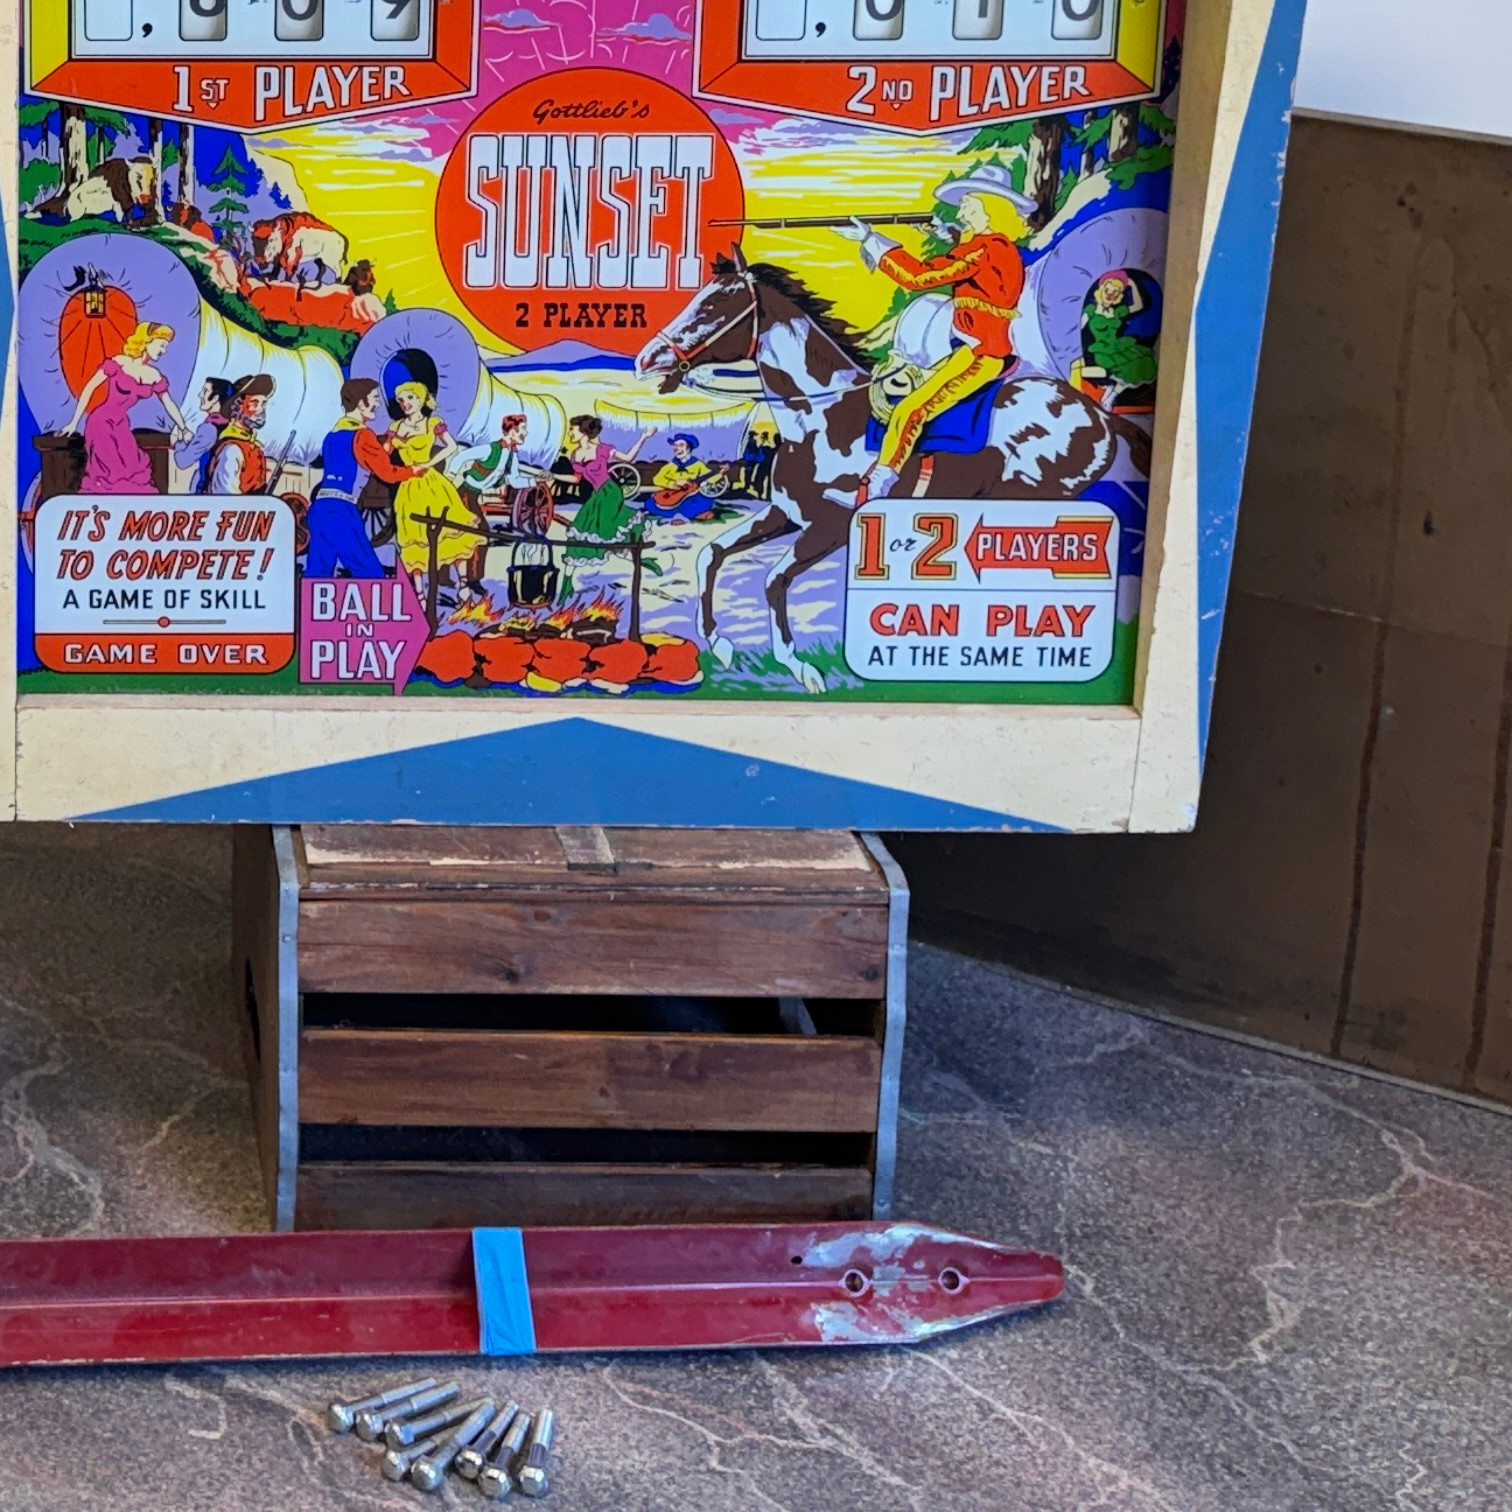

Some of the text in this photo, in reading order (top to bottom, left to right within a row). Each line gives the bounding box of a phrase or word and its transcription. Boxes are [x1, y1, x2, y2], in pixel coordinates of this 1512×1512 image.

[253, 65, 411, 122] PLAYER
[930, 65, 1090, 122] PLAYER
[532, 99, 650, 125] Gottlieb's
[464, 132, 715, 289] SUNSET
[515, 303, 647, 328] 2 PLAYER
[57, 505, 276, 542] IT'S MORE FUN
[854, 512, 1098, 580] 1 or 2 PLAYERS
[56, 549, 94, 581] TO
[62, 589, 266, 609] A GAME OF SKILL
[311, 582, 412, 622] BALL
[345, 622, 374, 637] IN
[869, 602, 1096, 637] CAN PLAY
[64, 643, 268, 665] GAME OVER
[310, 639, 407, 680] PLAY
[868, 645, 1091, 667] AT THE SAME TIME
